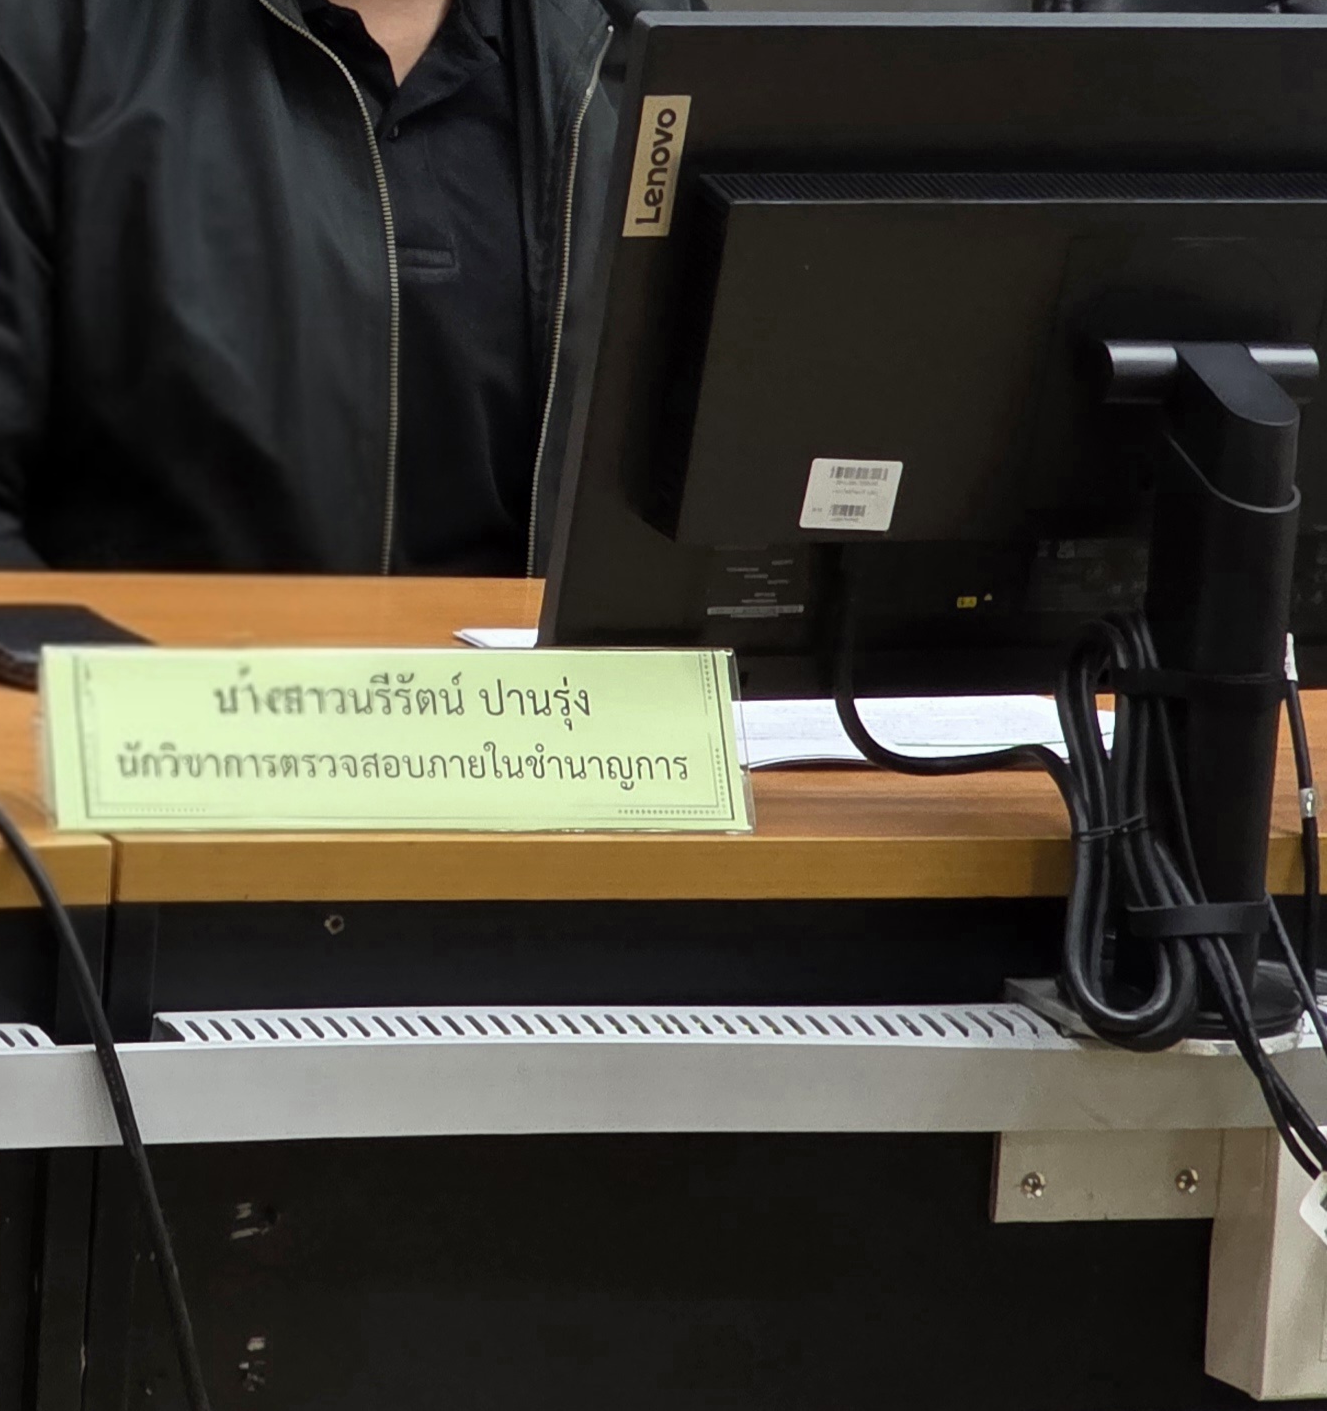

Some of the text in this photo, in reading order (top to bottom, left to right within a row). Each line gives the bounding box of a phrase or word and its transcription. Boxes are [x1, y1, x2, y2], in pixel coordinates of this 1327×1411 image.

[635, 108, 677, 225] Lenovo
[478, 675, 591, 732] ปานรุ่ง
[116, 740, 688, 792] นักวิชาการตรวจสอบภายในชำนาญการ
